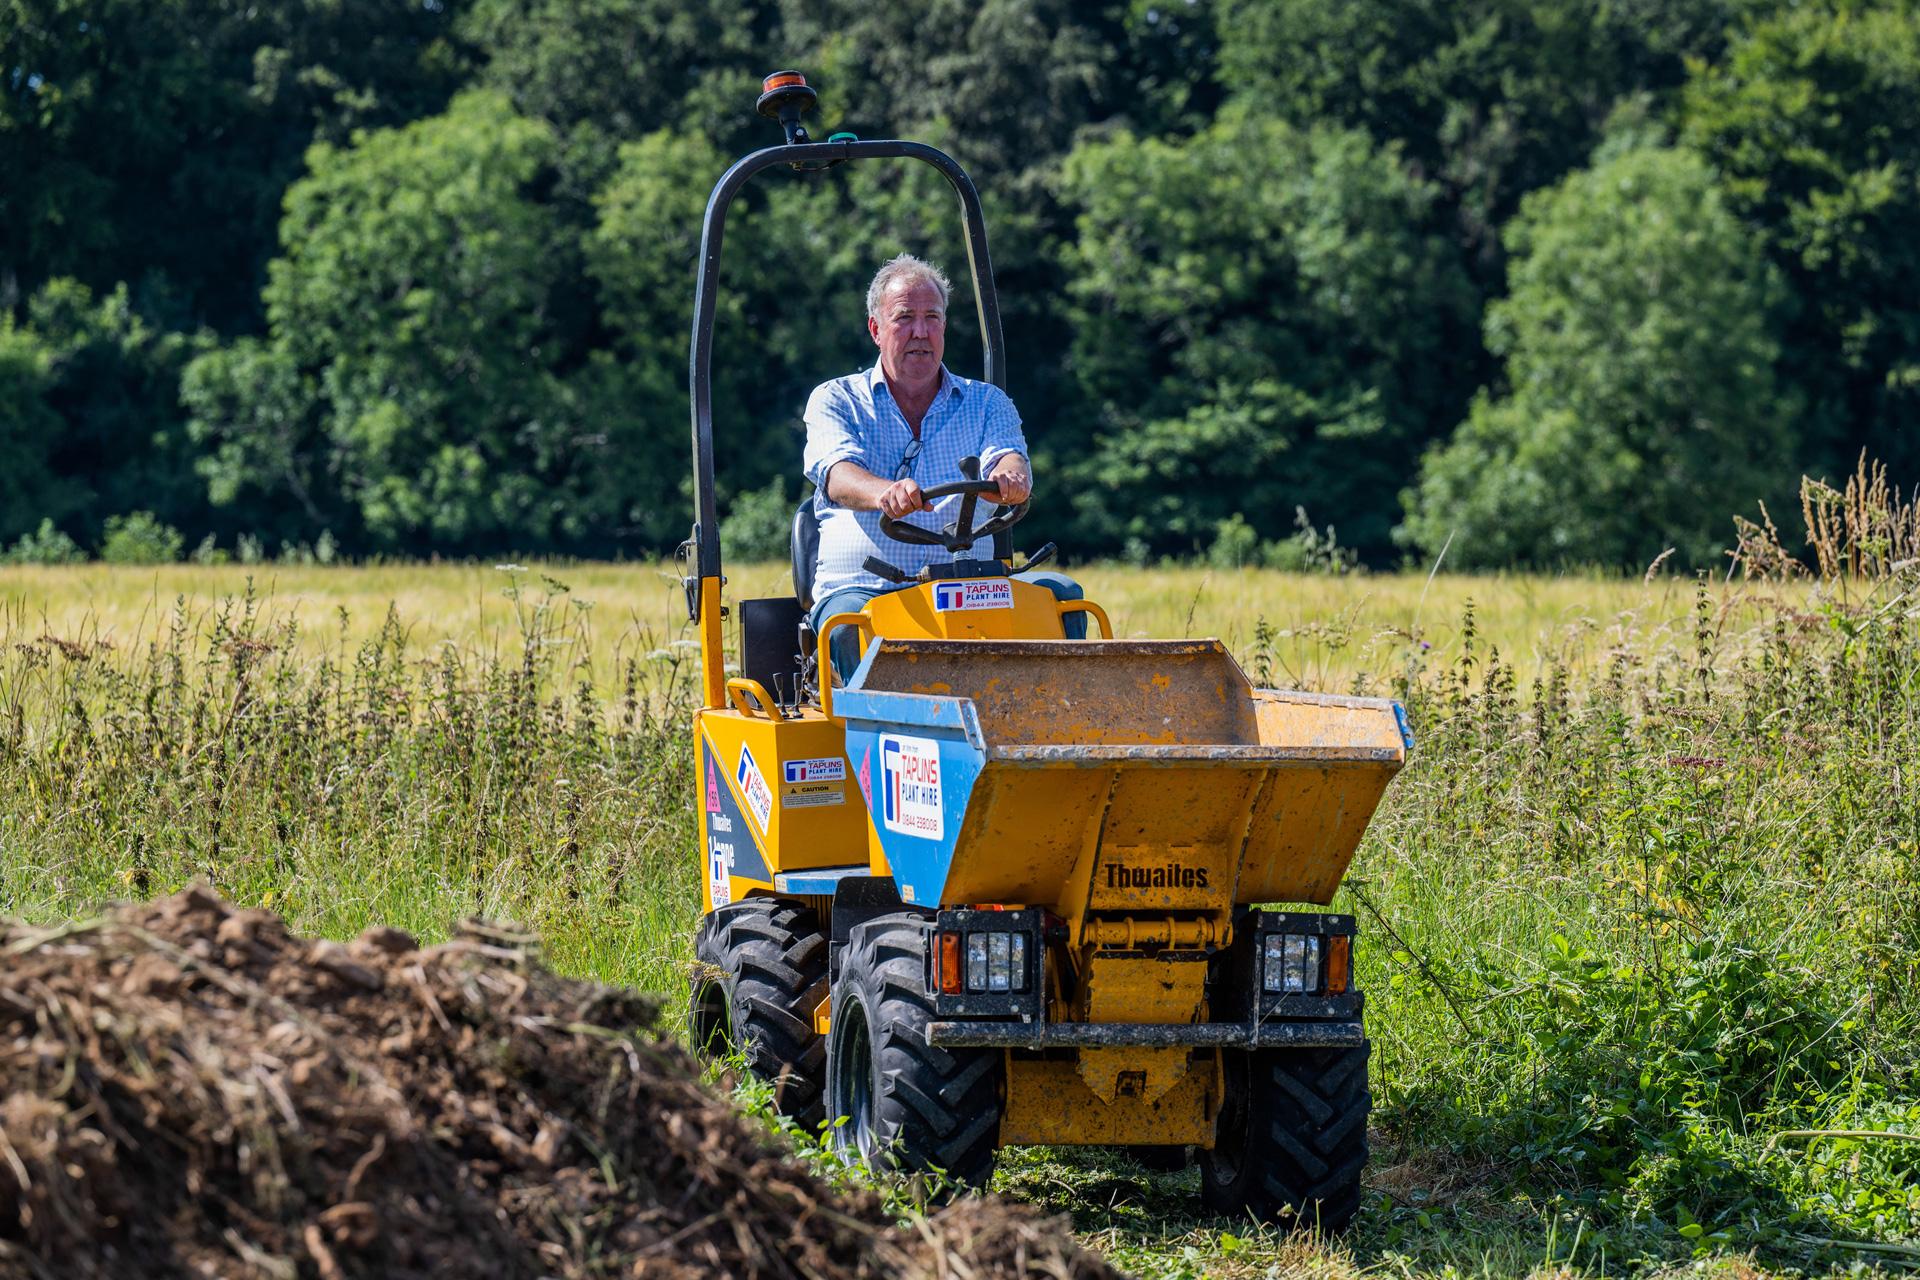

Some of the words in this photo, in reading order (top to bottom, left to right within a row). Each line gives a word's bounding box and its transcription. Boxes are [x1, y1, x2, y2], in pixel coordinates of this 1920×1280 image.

[966, 584, 1009, 594] TAPLINS
[808, 761, 843, 769] TAPLINS
[902, 754, 938, 784] TAPLINS
[902, 783, 919, 803] PLANT
[922, 786, 938, 807] HIRE
[1104, 863, 1208, 888] Thwaites
